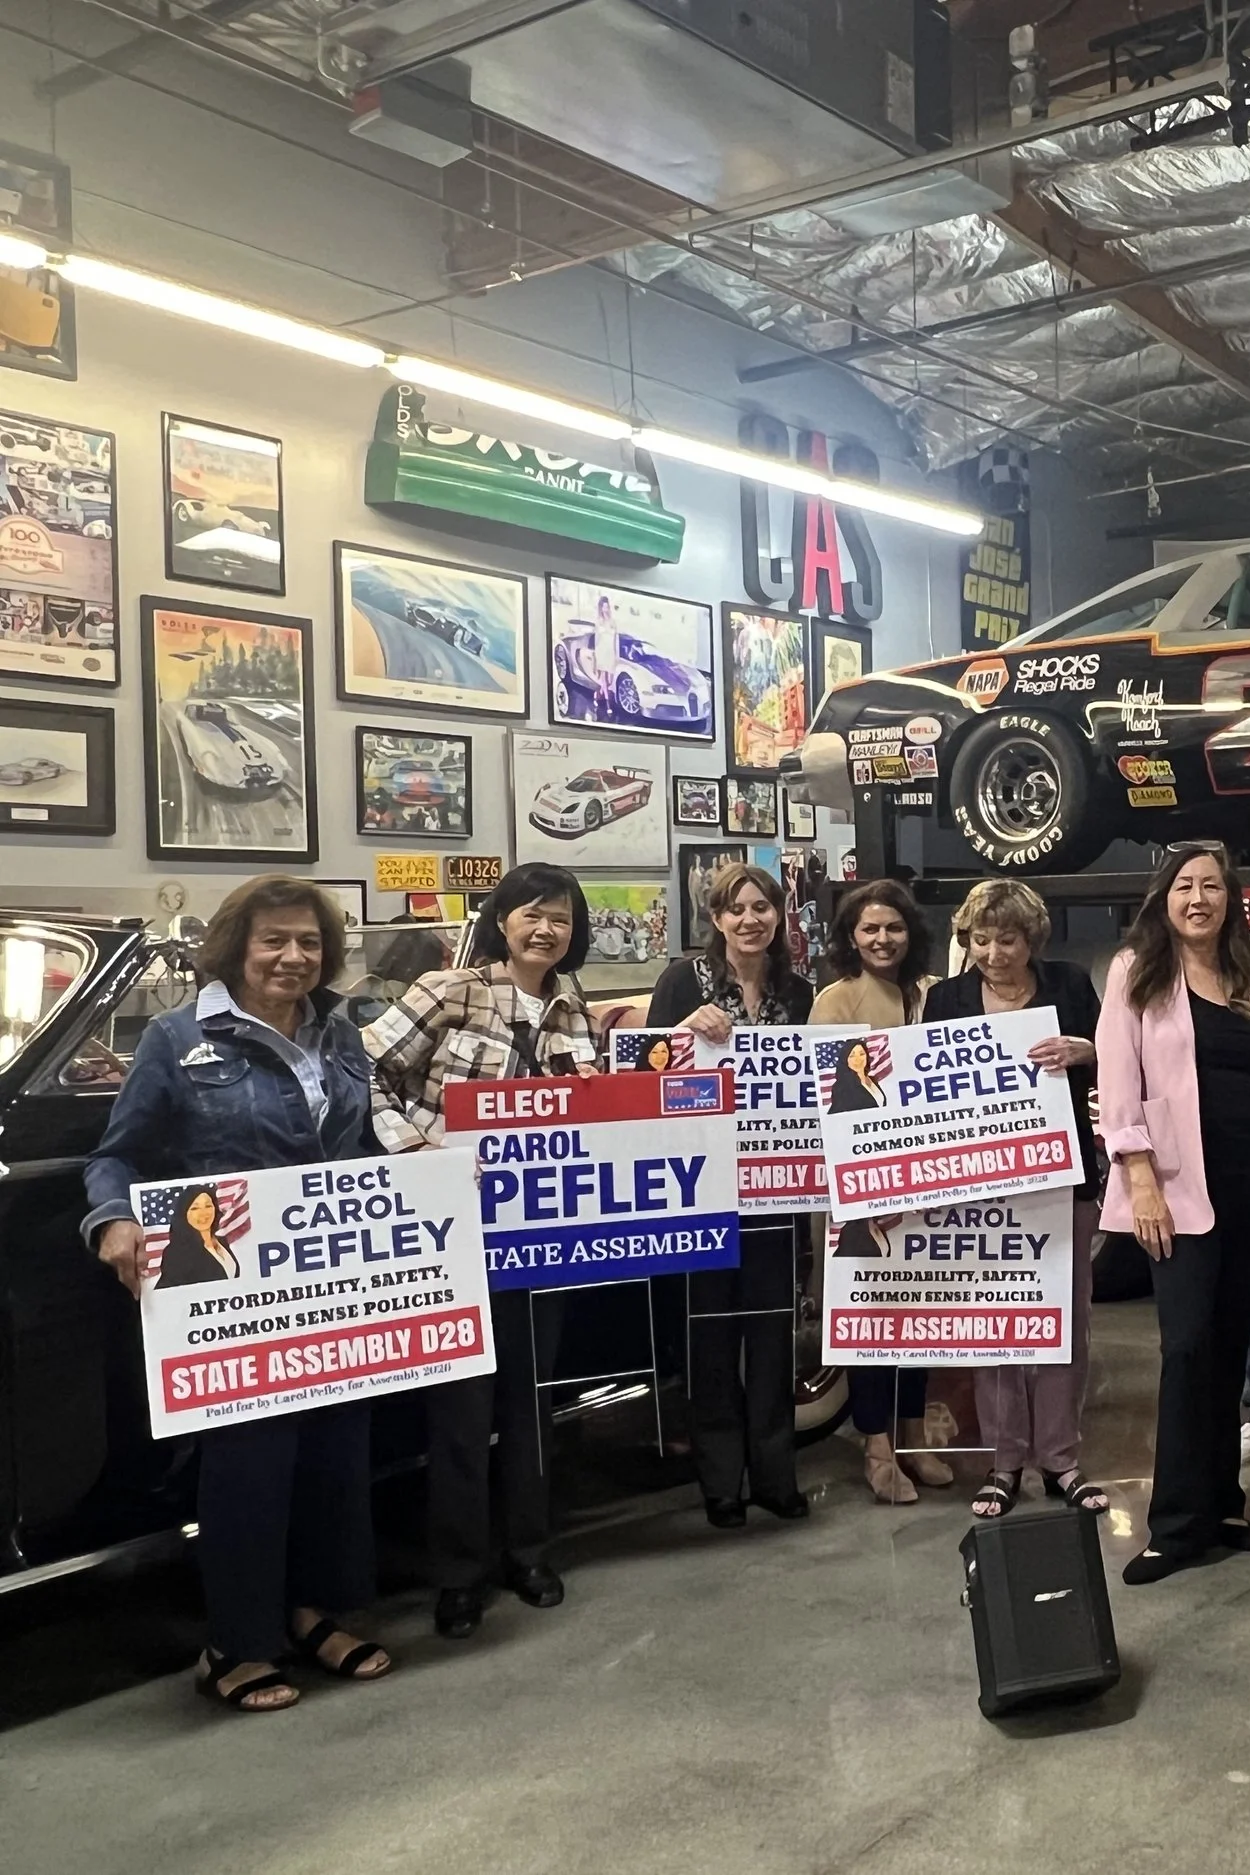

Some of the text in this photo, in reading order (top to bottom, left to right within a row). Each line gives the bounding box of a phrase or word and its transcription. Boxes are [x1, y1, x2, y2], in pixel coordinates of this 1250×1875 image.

[397, 385, 412, 439] OLDS
[10, 528, 40, 543] 100
[1017, 654, 1100, 679] SHOCKS
[966, 672, 999, 692] NAPA
[1014, 676, 1096, 695] Regal Ride
[849, 727, 903, 743] CRAFTSMAN
[1000, 716, 1050, 737] EAGLE
[1131, 791, 1173, 804] DIAMOND
[380, 877, 435, 886] STUPID
[735, 1033, 802, 1052] Elect
[927, 1022, 993, 1048] Elect
[914, 1042, 1013, 1072] CAROL
[734, 1081, 817, 1110] EFLE
[899, 1063, 1043, 1107] PEFLEY
[476, 1088, 572, 1120] ELECT
[853, 1098, 1042, 1135] AFFORDABILITY, SAFETY,
[478, 1130, 590, 1165] CAROL
[852, 1117, 1047, 1156] COMMON SENSE POLICIES
[301, 1166, 391, 1198] Elect
[739, 1165, 808, 1190] EMBLY
[841, 1164, 905, 1196] STATE
[910, 1146, 1016, 1186] ASSEMBLY
[1022, 1139, 1066, 1168] D28
[480, 1156, 707, 1225] PEFLEY
[282, 1192, 415, 1231] CAROL
[924, 1208, 1021, 1228] CAROL
[258, 1217, 454, 1278] PEFLEY
[487, 1228, 729, 1271] TATE ASSEMBLY
[904, 1234, 1050, 1261] PEFLEY
[189, 1265, 449, 1318] AFFORDABILITY, SAFETY,
[854, 1270, 1041, 1284] AFFORDABILITY, SAFETY,
[850, 1290, 1044, 1303] COMMON SENSE POLICIES
[187, 1289, 454, 1345] COMMON SENSE POLICIES
[836, 1316, 1057, 1341] STATE ASSEMBLY D28
[171, 1318, 476, 1400] STATE ASSEMBLY D28
